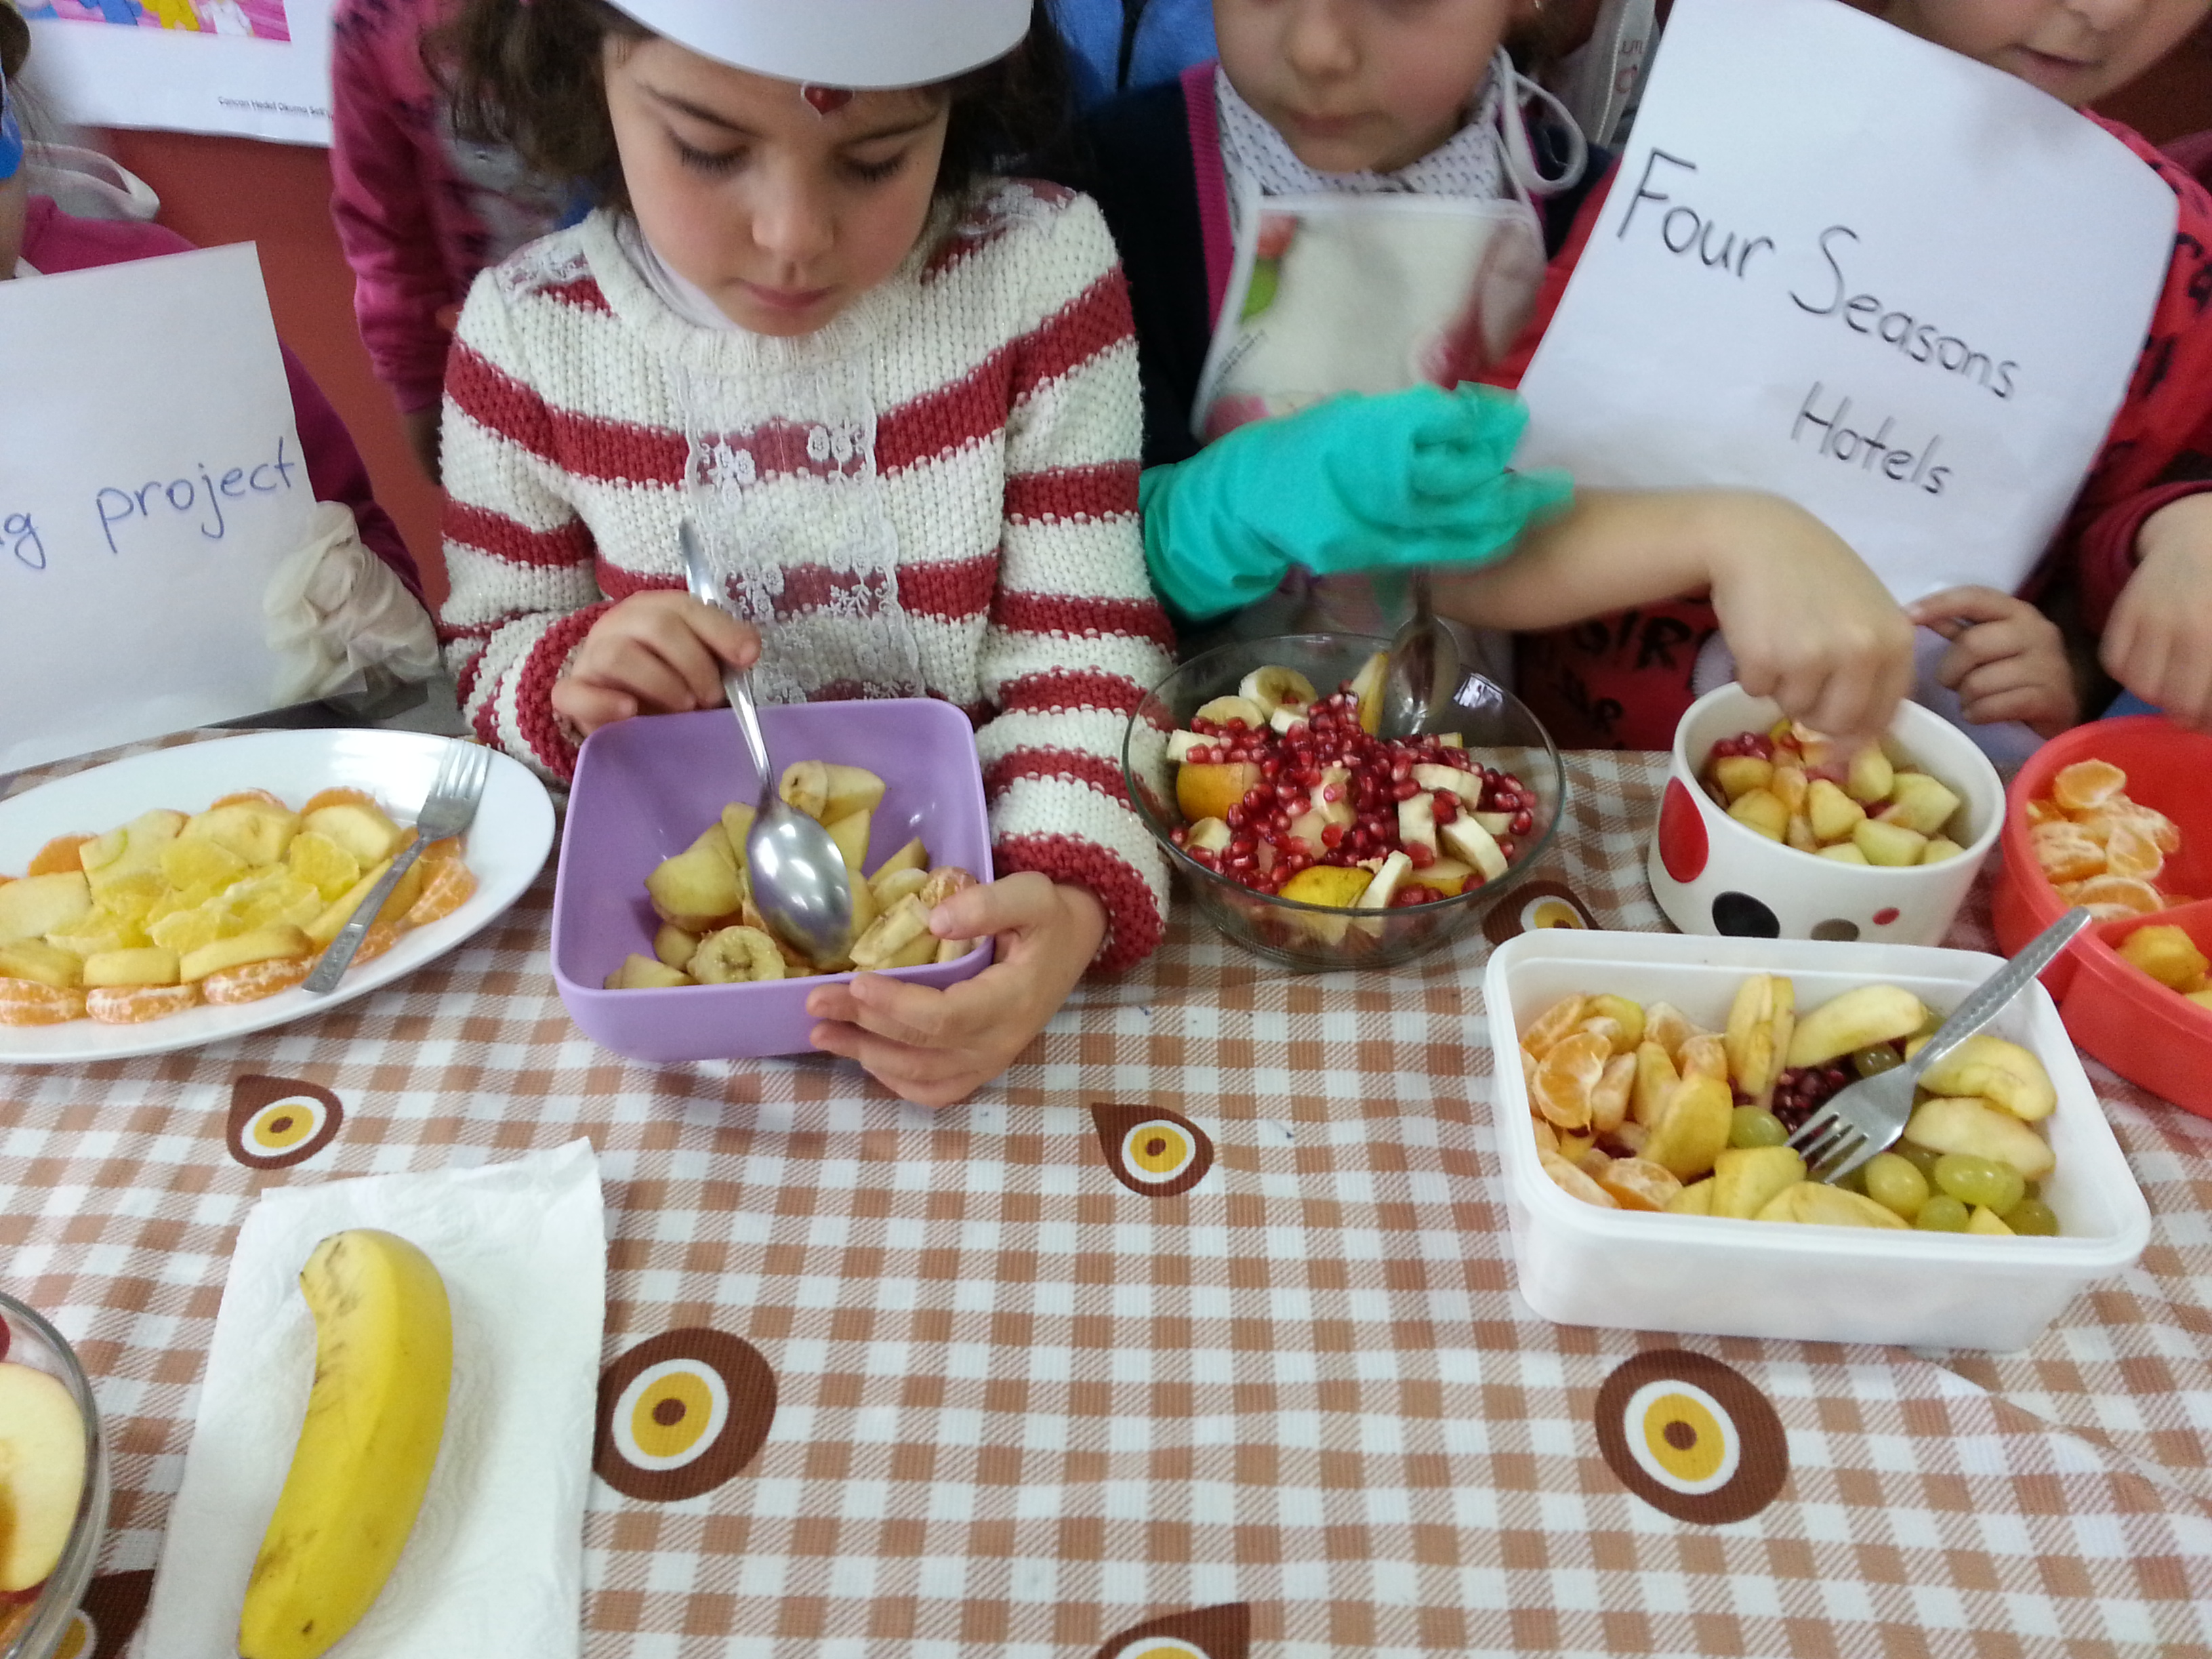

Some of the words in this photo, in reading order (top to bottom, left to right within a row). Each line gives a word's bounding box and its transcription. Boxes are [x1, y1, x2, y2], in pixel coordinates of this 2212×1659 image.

[1617, 147, 1776, 279] Four
[1788, 224, 2021, 400] Seasons
[0, 512, 47, 570] g
[96, 436, 294, 554] project
[1790, 380, 1952, 495] Hotels
